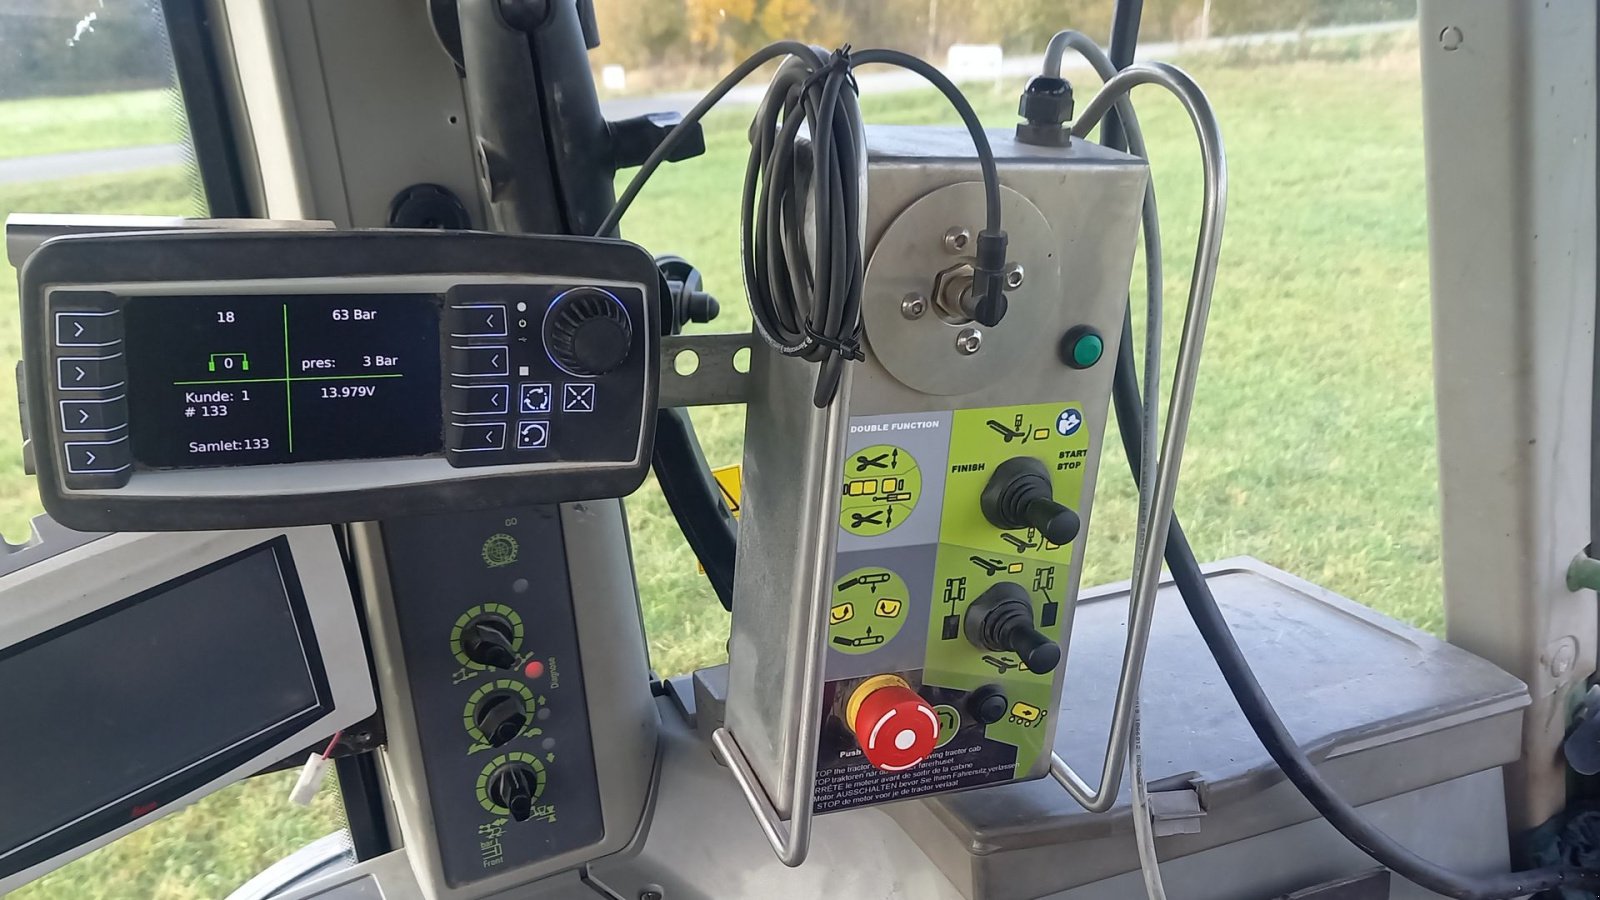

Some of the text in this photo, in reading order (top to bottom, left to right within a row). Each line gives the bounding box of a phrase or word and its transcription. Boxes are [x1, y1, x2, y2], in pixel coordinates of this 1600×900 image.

[216, 311, 236, 324] 18
[332, 309, 377, 321] 63 Bar
[223, 357, 234, 370] 0
[301, 355, 398, 371] pres: 3 Bar
[184, 389, 250, 404] Kunde: 1
[320, 385, 376, 399] 13.979V
[184, 405, 228, 418] # 133
[850, 420, 940, 434] DOUBLE FUNCTION
[1058, 448, 1088, 459] START
[951, 463, 986, 473] FINISH
[1056, 461, 1082, 471] STOP
[839, 749, 862, 758] Push
[816, 769, 833, 777] TOP
[847, 763, 871, 773] tractor
[945, 747, 967, 757] tractor
[968, 745, 982, 753] cab
[815, 777, 831, 786] TOP
[831, 772, 865, 784] traktoren
[815, 782, 844, 794] RRÊTE
[853, 778, 880, 788] moteur
[880, 774, 900, 783] avant
[836, 783, 898, 798] AUSSCHALTEN
[898, 779, 919, 788] bevor
[816, 800, 840, 810] STOP
[852, 795, 874, 804] motor
[874, 791, 891, 799] voor
[892, 790, 899, 798] je
[911, 784, 934, 794] tractor
[482, 856, 504, 868] Front
